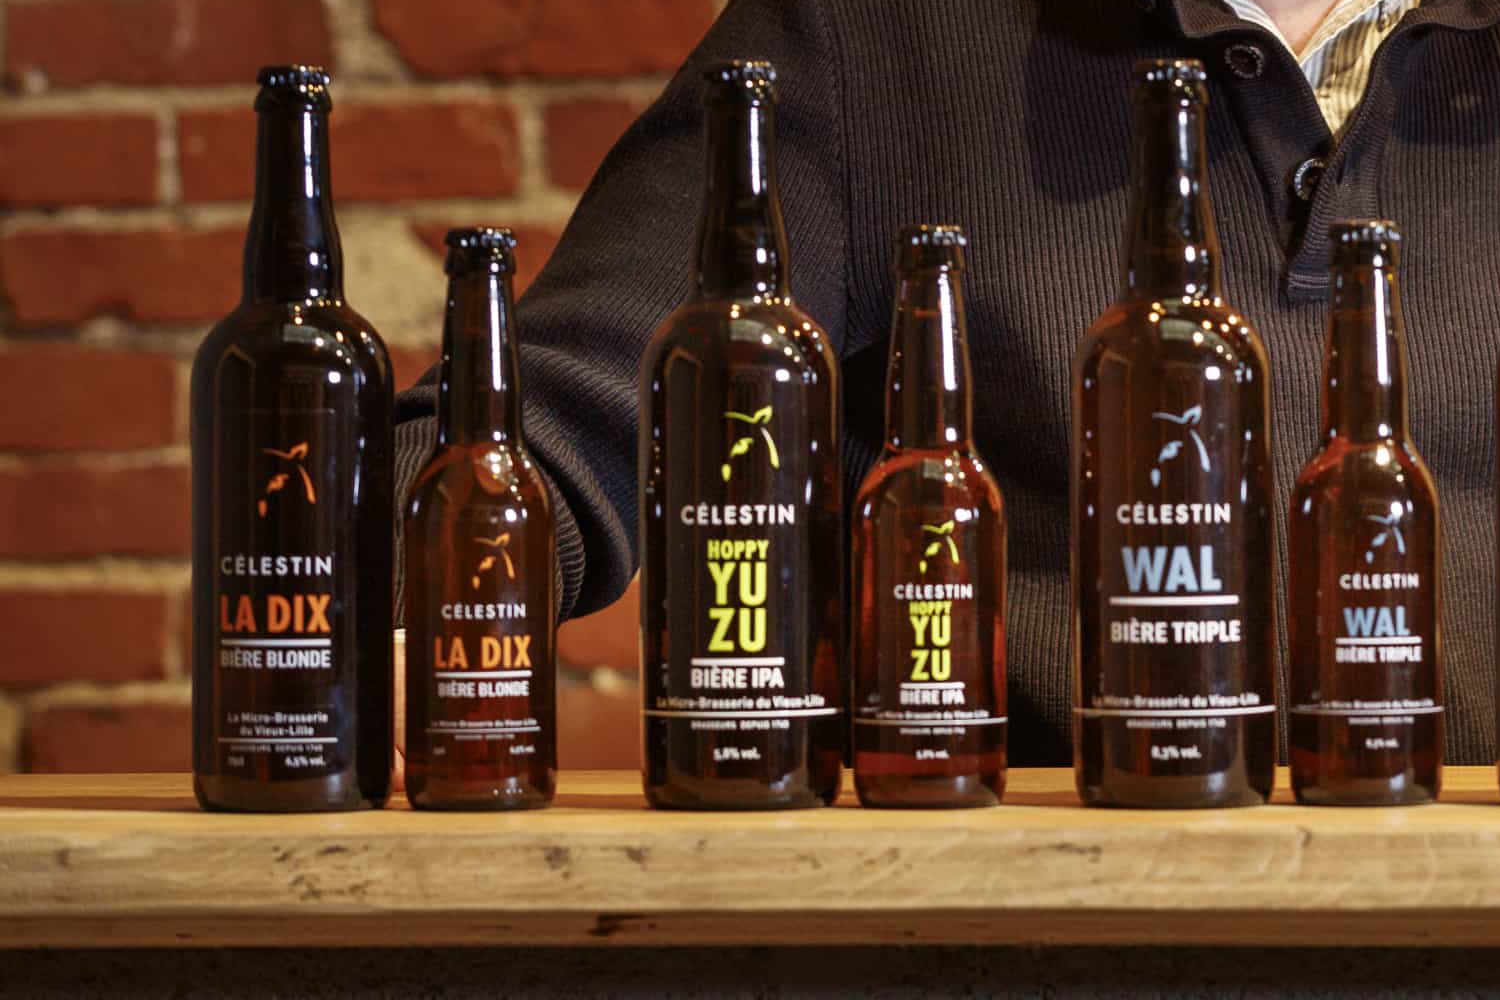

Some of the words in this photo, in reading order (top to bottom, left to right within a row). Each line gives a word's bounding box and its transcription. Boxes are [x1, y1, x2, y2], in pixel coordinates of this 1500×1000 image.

[680, 501, 796, 525] CÉLESTIN
[1116, 501, 1231, 525] CÉLESTIN
[707, 538, 770, 560] HOPPY
[221, 552, 332, 576] CÉLESTIN
[1121, 545, 1222, 593] WAL
[707, 560, 769, 606] YU
[893, 582, 973, 600] CÉLESTIN
[1339, 572, 1419, 590] CÉLESTIN
[220, 594, 257, 633] LA
[266, 594, 332, 633] DIX
[441, 601, 527, 619] CÉLESTIN
[1343, 605, 1411, 637] WAL
[708, 607, 768, 653] ZU
[909, 615, 952, 647] YU
[1110, 616, 1168, 643] BIÈRE
[1171, 619, 1241, 643] TRIPLE
[220, 647, 263, 669] BIÈRE
[266, 648, 332, 670] BLONDE
[434, 635, 469, 669] LA
[481, 634, 532, 669] DIX
[1378, 645, 1422, 662] TRIPLE
[690, 664, 748, 689] BIÈRE
[751, 667, 785, 689] IPA
[910, 649, 951, 681] ZU
[437, 680, 476, 698] BIÈRE
[478, 680, 530, 698] BLONDE
[942, 688, 965, 705] IPA
[669, 695, 754, 709] Micro-Brasserie
[756, 697, 771, 709] du
[772, 694, 825, 708] Vieux-Lille
[1191, 695, 1207, 708] du
[241, 710, 329, 724] Micro-Brasserie
[254, 724, 315, 736] Vieux-Lille
